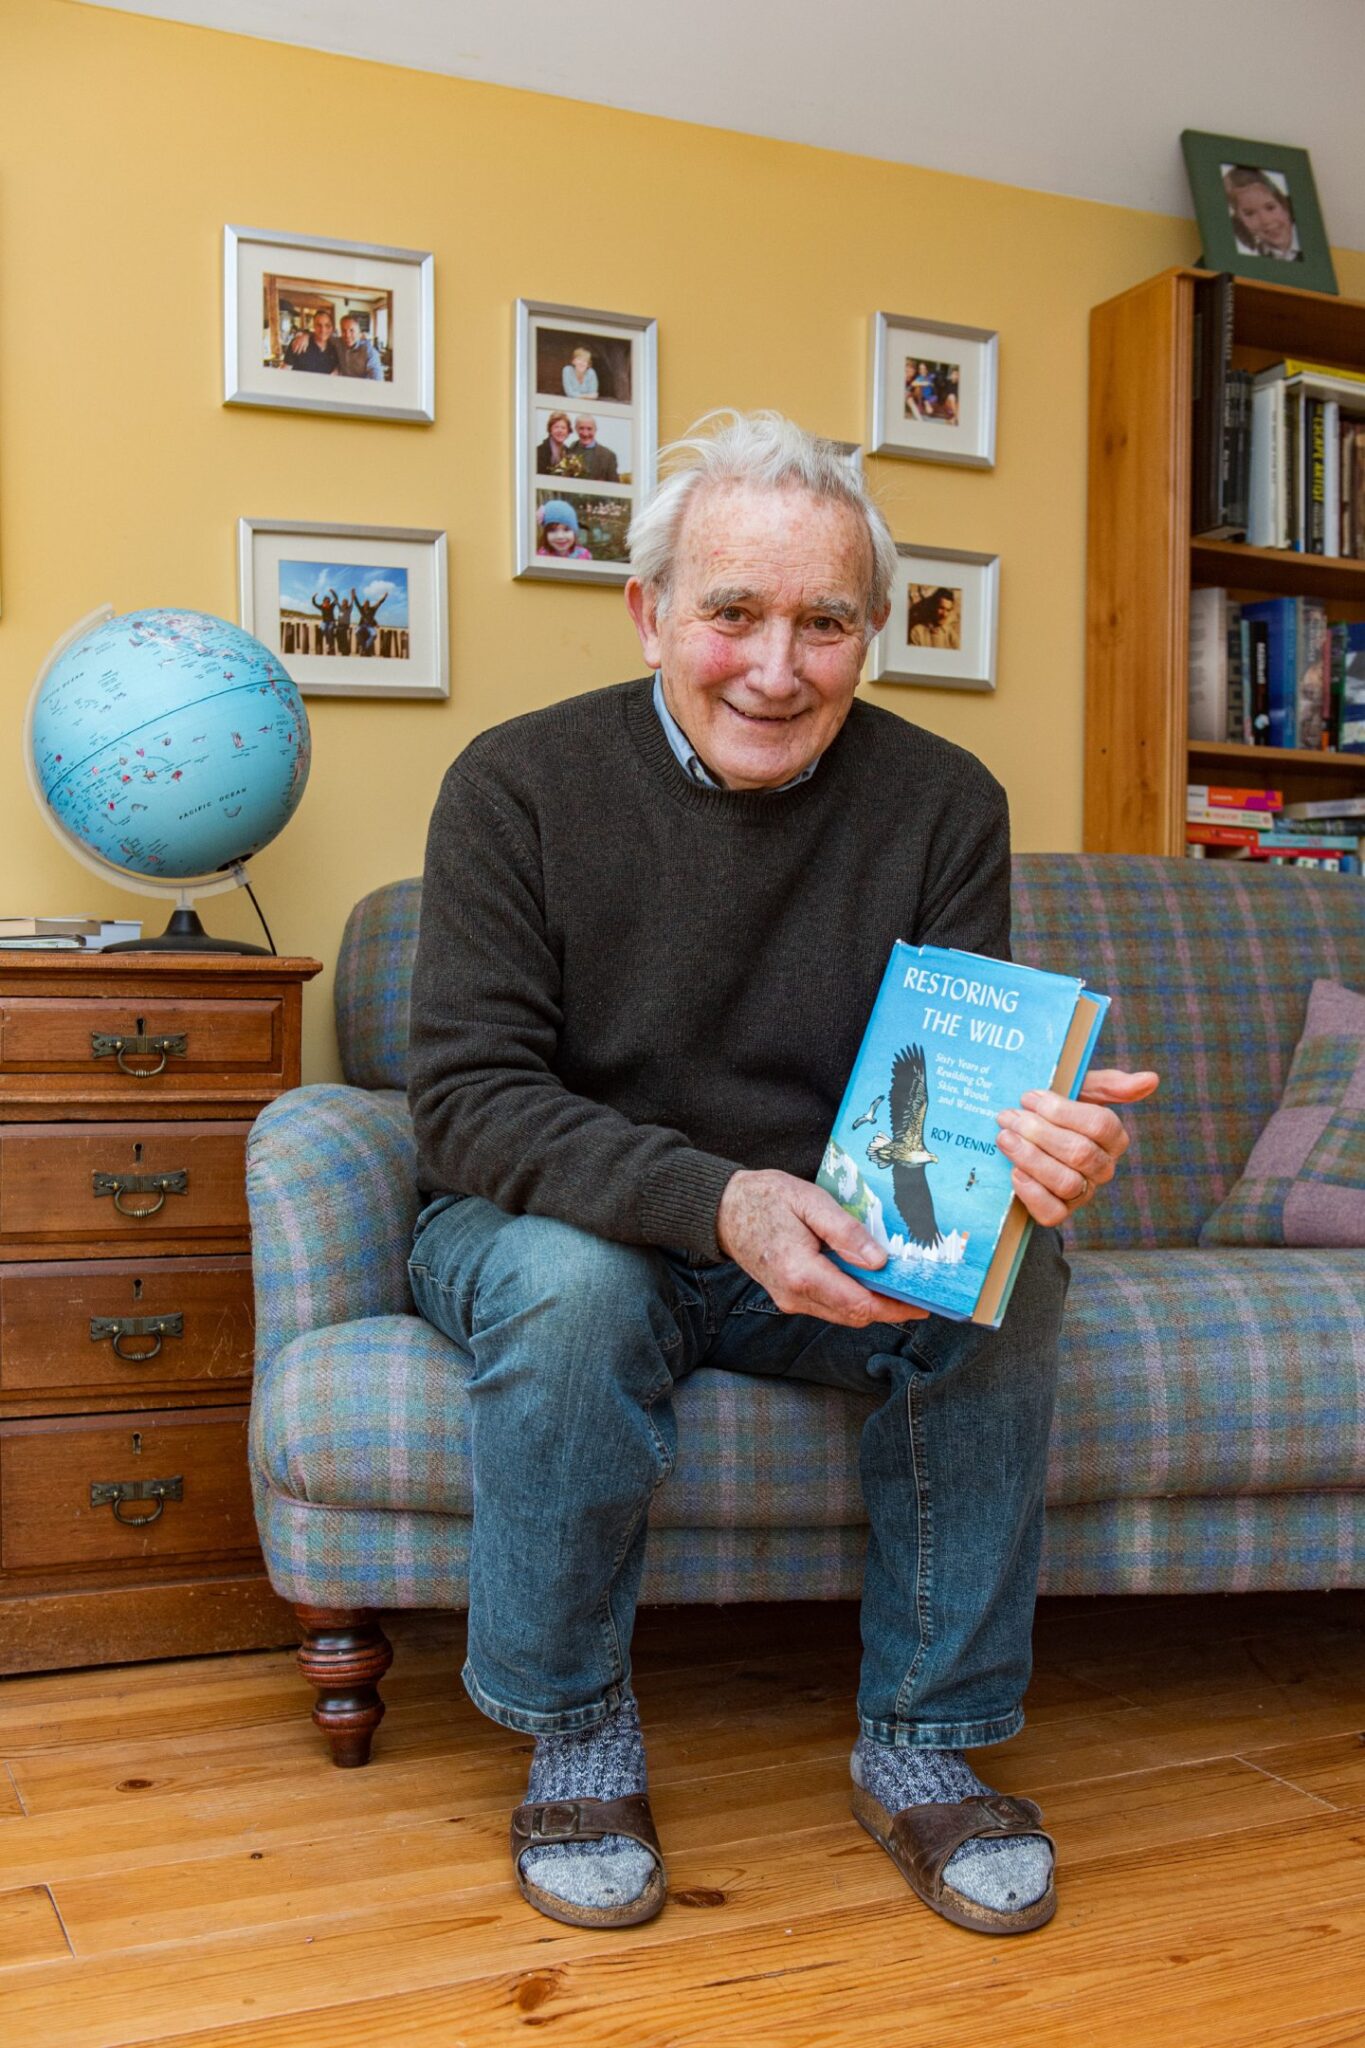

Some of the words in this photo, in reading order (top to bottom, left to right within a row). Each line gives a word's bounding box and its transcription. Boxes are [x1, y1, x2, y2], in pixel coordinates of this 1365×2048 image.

[178, 801, 212, 820] PACIFIC
[219, 787, 247, 802] OCEAN
[903, 966, 1020, 1013] RESTORING
[922, 1007, 963, 1037] THE
[970, 1018, 1025, 1052] WILD
[935, 1052, 955, 1068] Sixty
[958, 1058, 979, 1072] Years
[980, 1064, 992, 1075] of
[936, 1065, 975, 1087] Rewilding
[976, 1077, 993, 1089] Our
[938, 1096, 955, 1106] and
[963, 1087, 990, 1102] Woods
[930, 1127, 954, 1143] ROY
[955, 1134, 998, 1156] DENNIS
